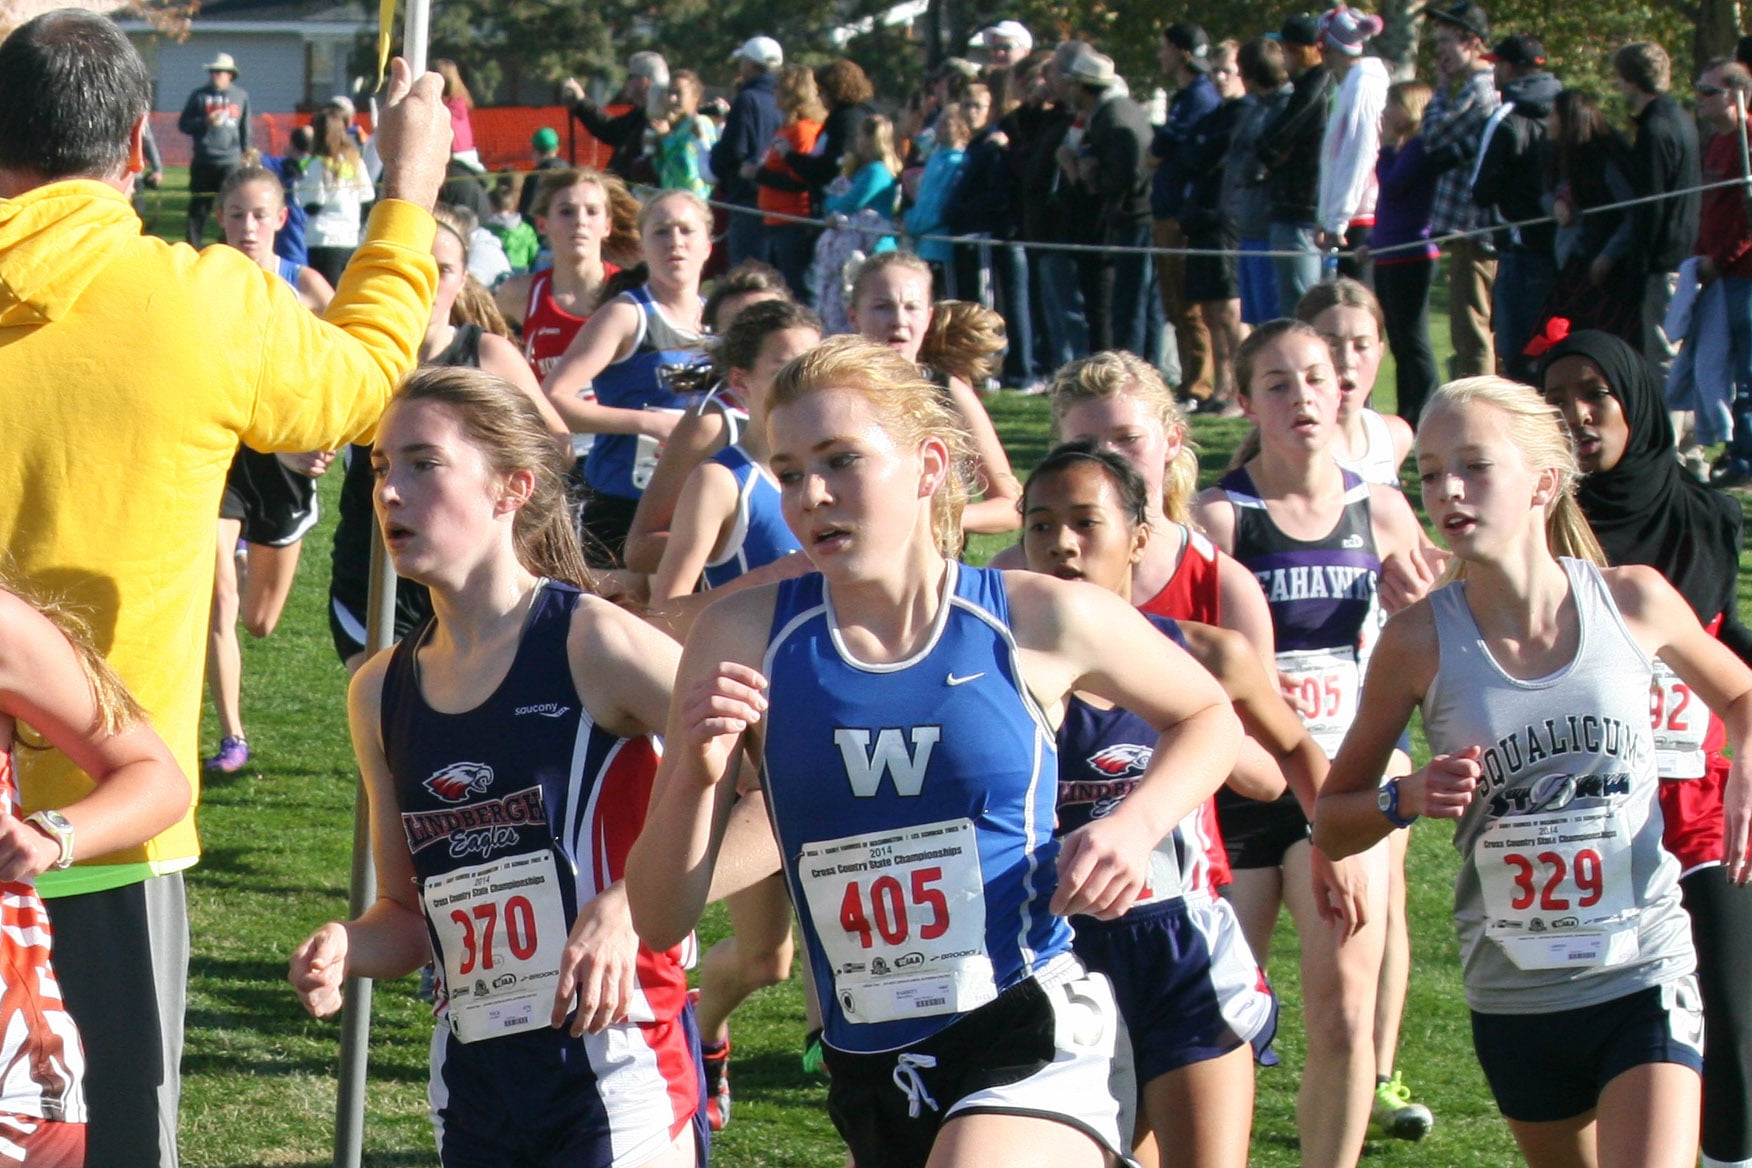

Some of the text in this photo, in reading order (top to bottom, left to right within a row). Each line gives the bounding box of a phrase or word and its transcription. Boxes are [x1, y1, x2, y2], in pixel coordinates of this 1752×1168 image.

[515, 703, 558, 715] saucony
[1281, 676, 1341, 719] 05
[834, 725, 942, 797] W
[403, 787, 545, 850] LINDBERGH
[450, 824, 519, 857] Eagles
[870, 846, 893, 858] 2014
[1484, 839, 1504, 849] Cross
[1506, 837, 1535, 848] Country
[811, 846, 962, 878] Cross Country State Championships
[1503, 849, 1603, 911] 329
[433, 876, 545, 908] Cross Country State Championships
[840, 866, 950, 949] 405
[450, 895, 538, 975] 370
